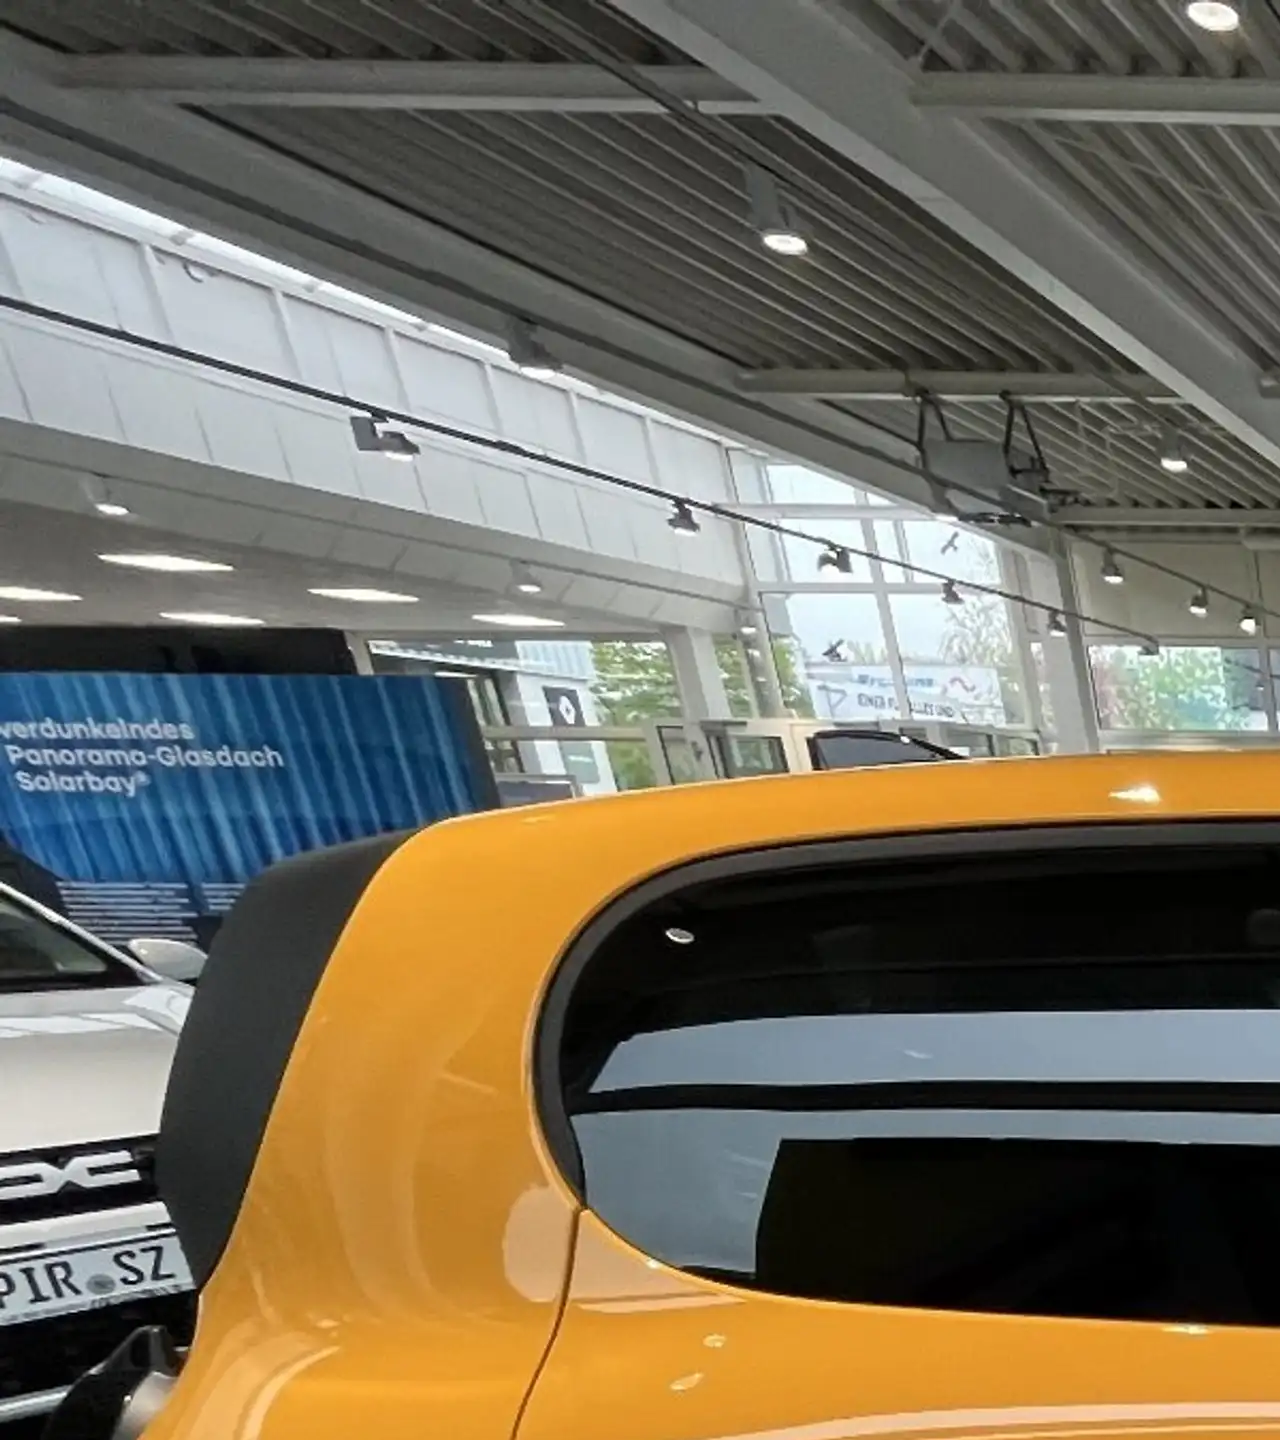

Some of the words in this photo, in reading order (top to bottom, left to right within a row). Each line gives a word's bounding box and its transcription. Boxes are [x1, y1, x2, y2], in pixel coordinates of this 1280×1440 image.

[0, 717, 196, 740] verdunkelndes
[7, 744, 285, 768] Panorama-Glasdach
[113, 1245, 177, 1286] SZ
